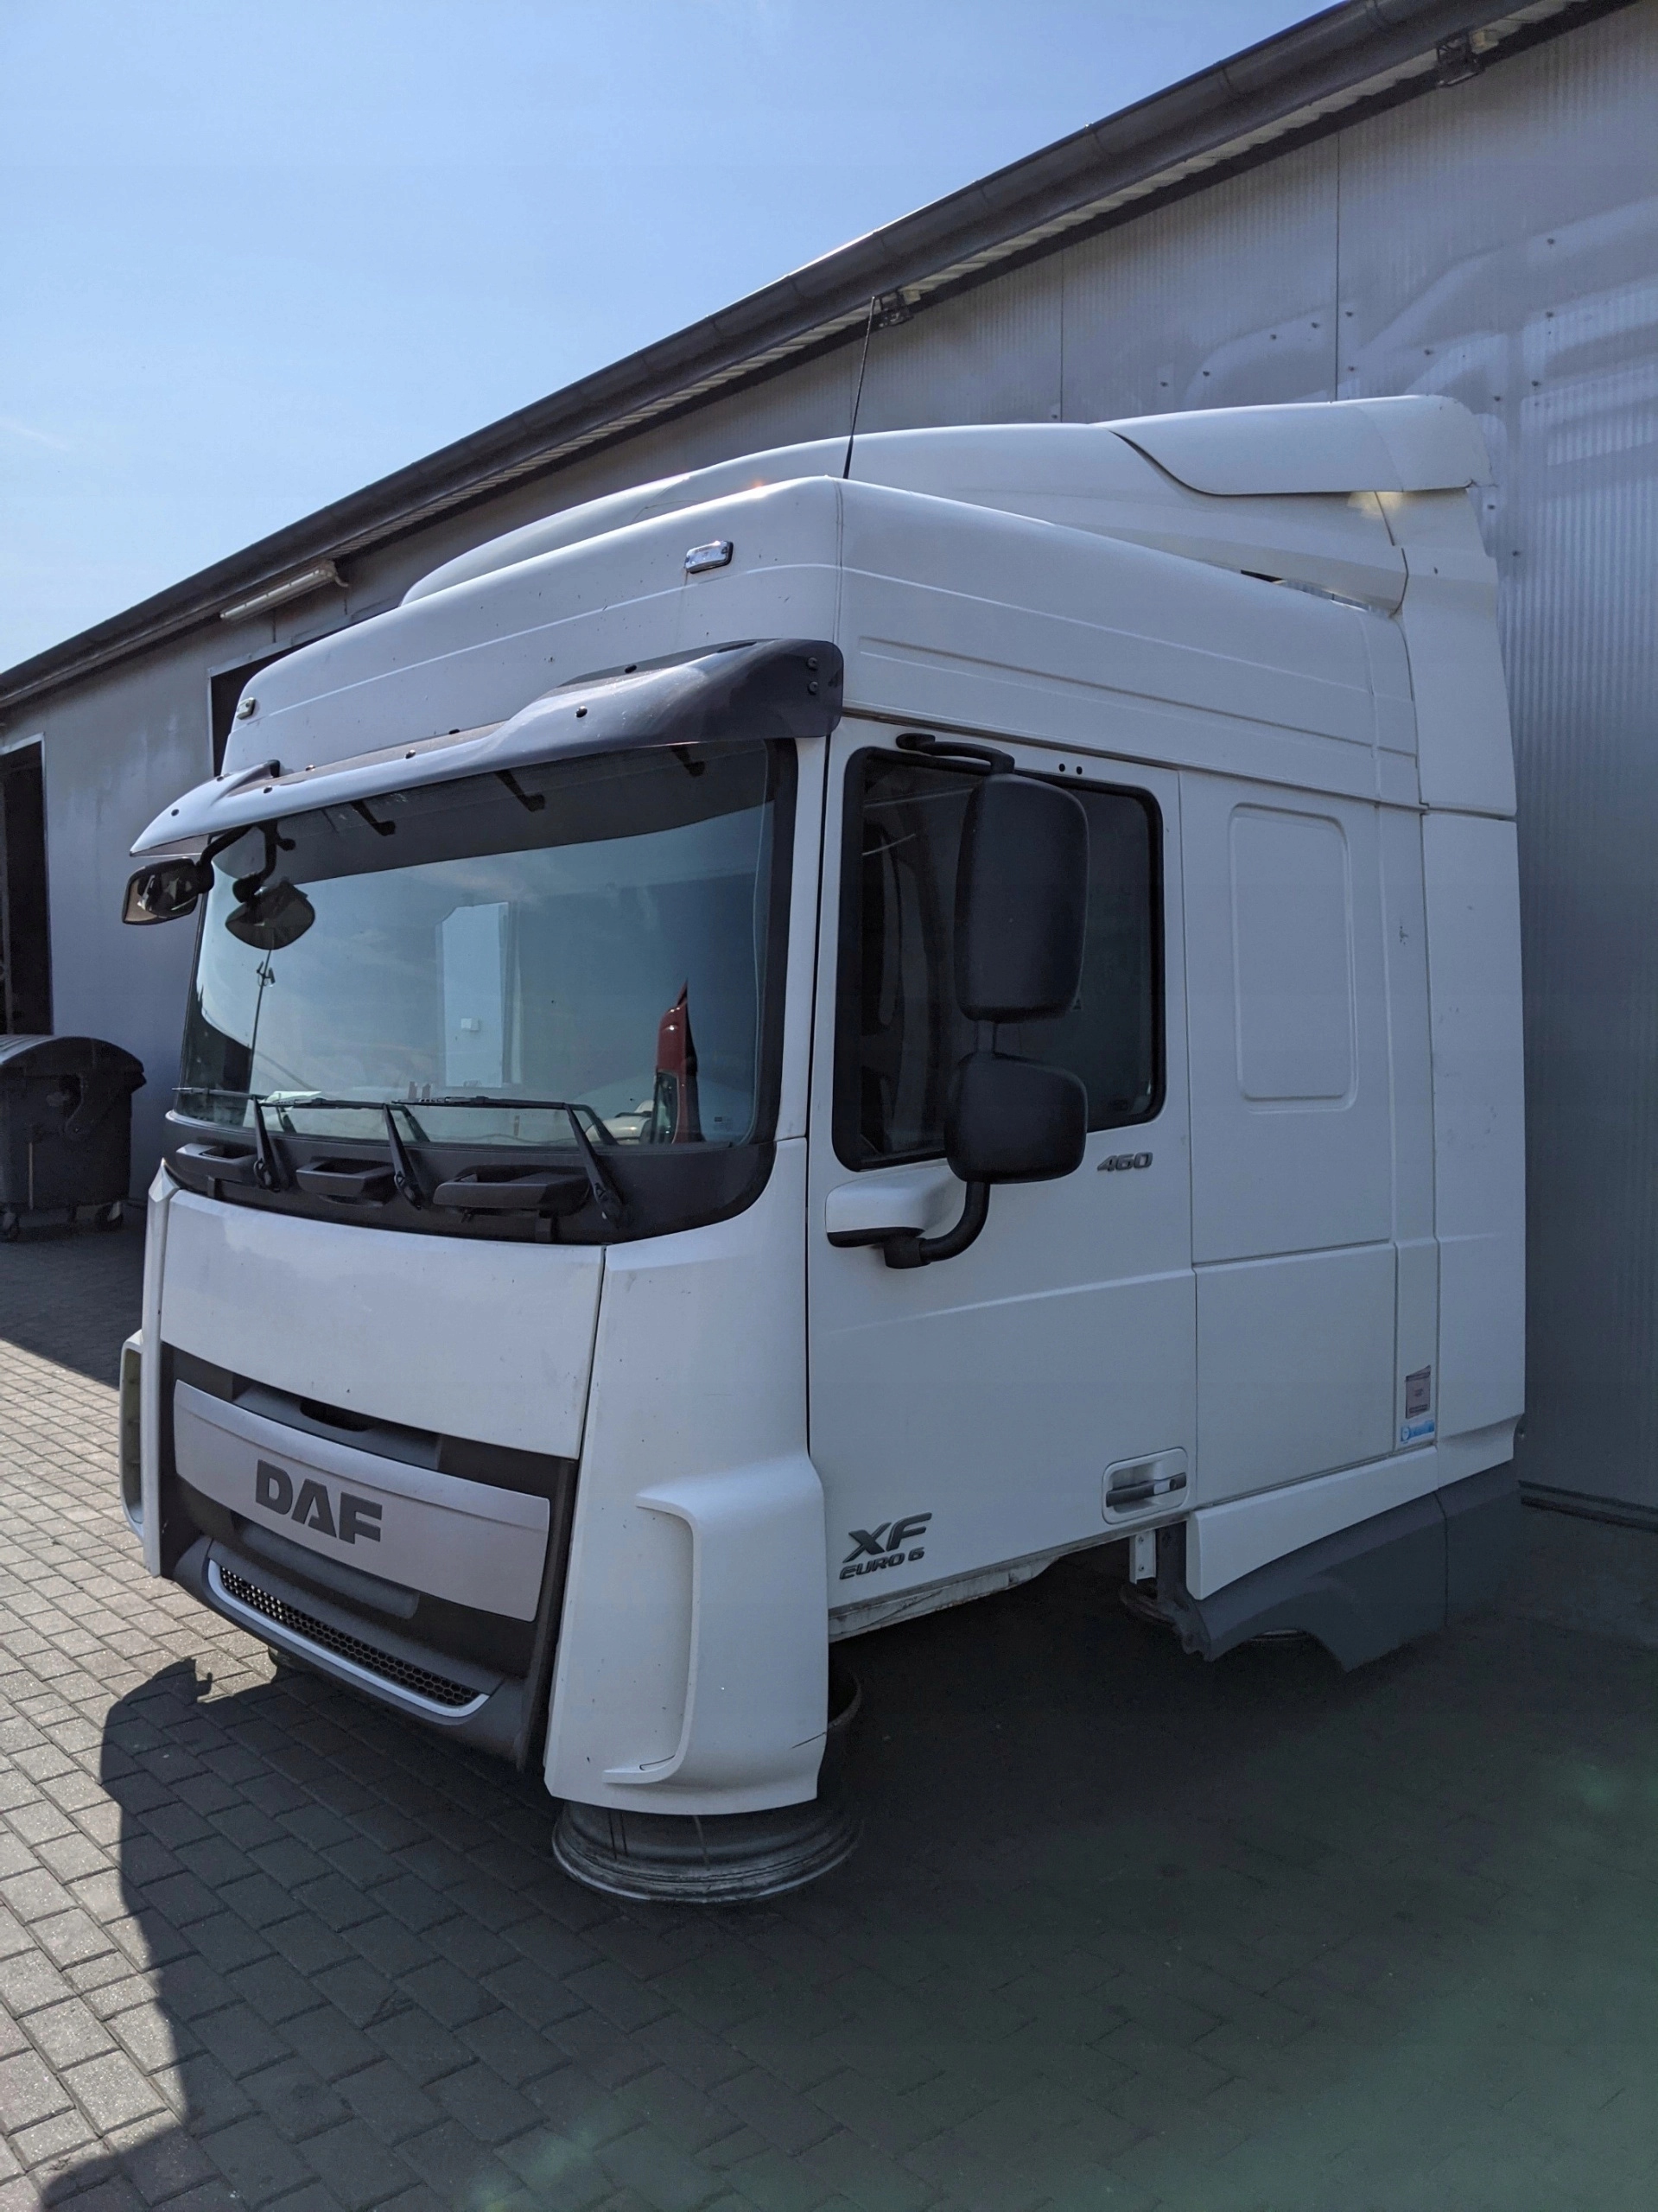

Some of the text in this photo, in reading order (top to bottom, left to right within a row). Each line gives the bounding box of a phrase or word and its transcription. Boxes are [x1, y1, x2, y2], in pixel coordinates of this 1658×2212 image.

[1097, 1152, 1153, 1172] 460
[255, 1459, 383, 1545] DAF
[842, 1511, 932, 1563] XF
[839, 1546, 925, 1580] EURO 6
